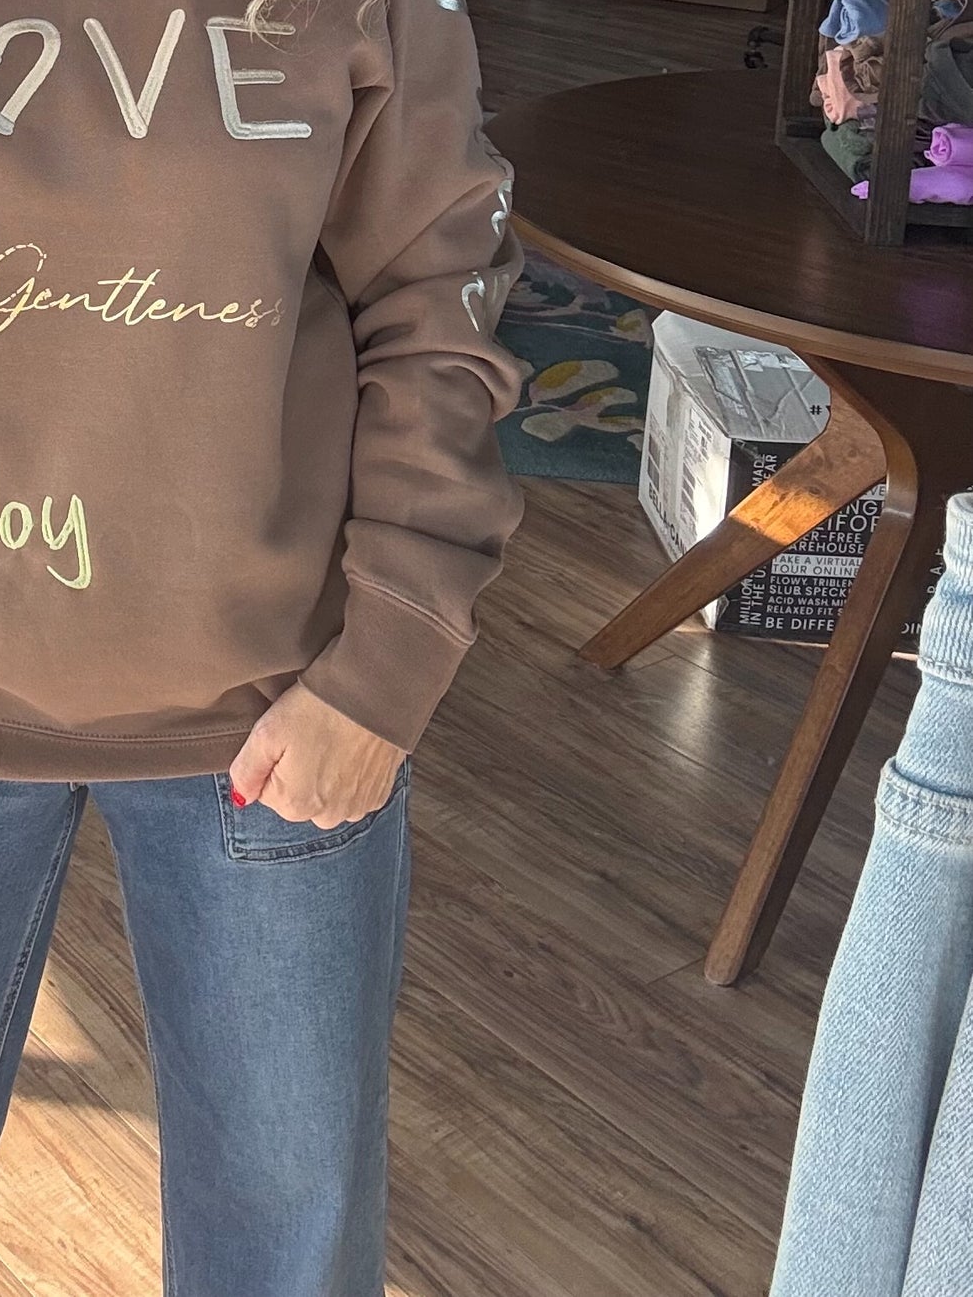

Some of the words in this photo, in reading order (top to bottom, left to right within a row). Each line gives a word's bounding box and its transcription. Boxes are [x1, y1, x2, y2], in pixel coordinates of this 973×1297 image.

[788, 541, 865, 554] AREHOUSE
[804, 557, 812, 565] A
[816, 557, 861, 567] VIRTUAL
[773, 564, 807, 574] TOUR
[751, 583, 765, 607] THE
[805, 587, 850, 598] SPECK
[768, 596, 794, 605] ACID
[766, 605, 814, 615] RELAXED
[765, 617, 784, 629] BE
[790, 619, 835, 632] DIFFE
